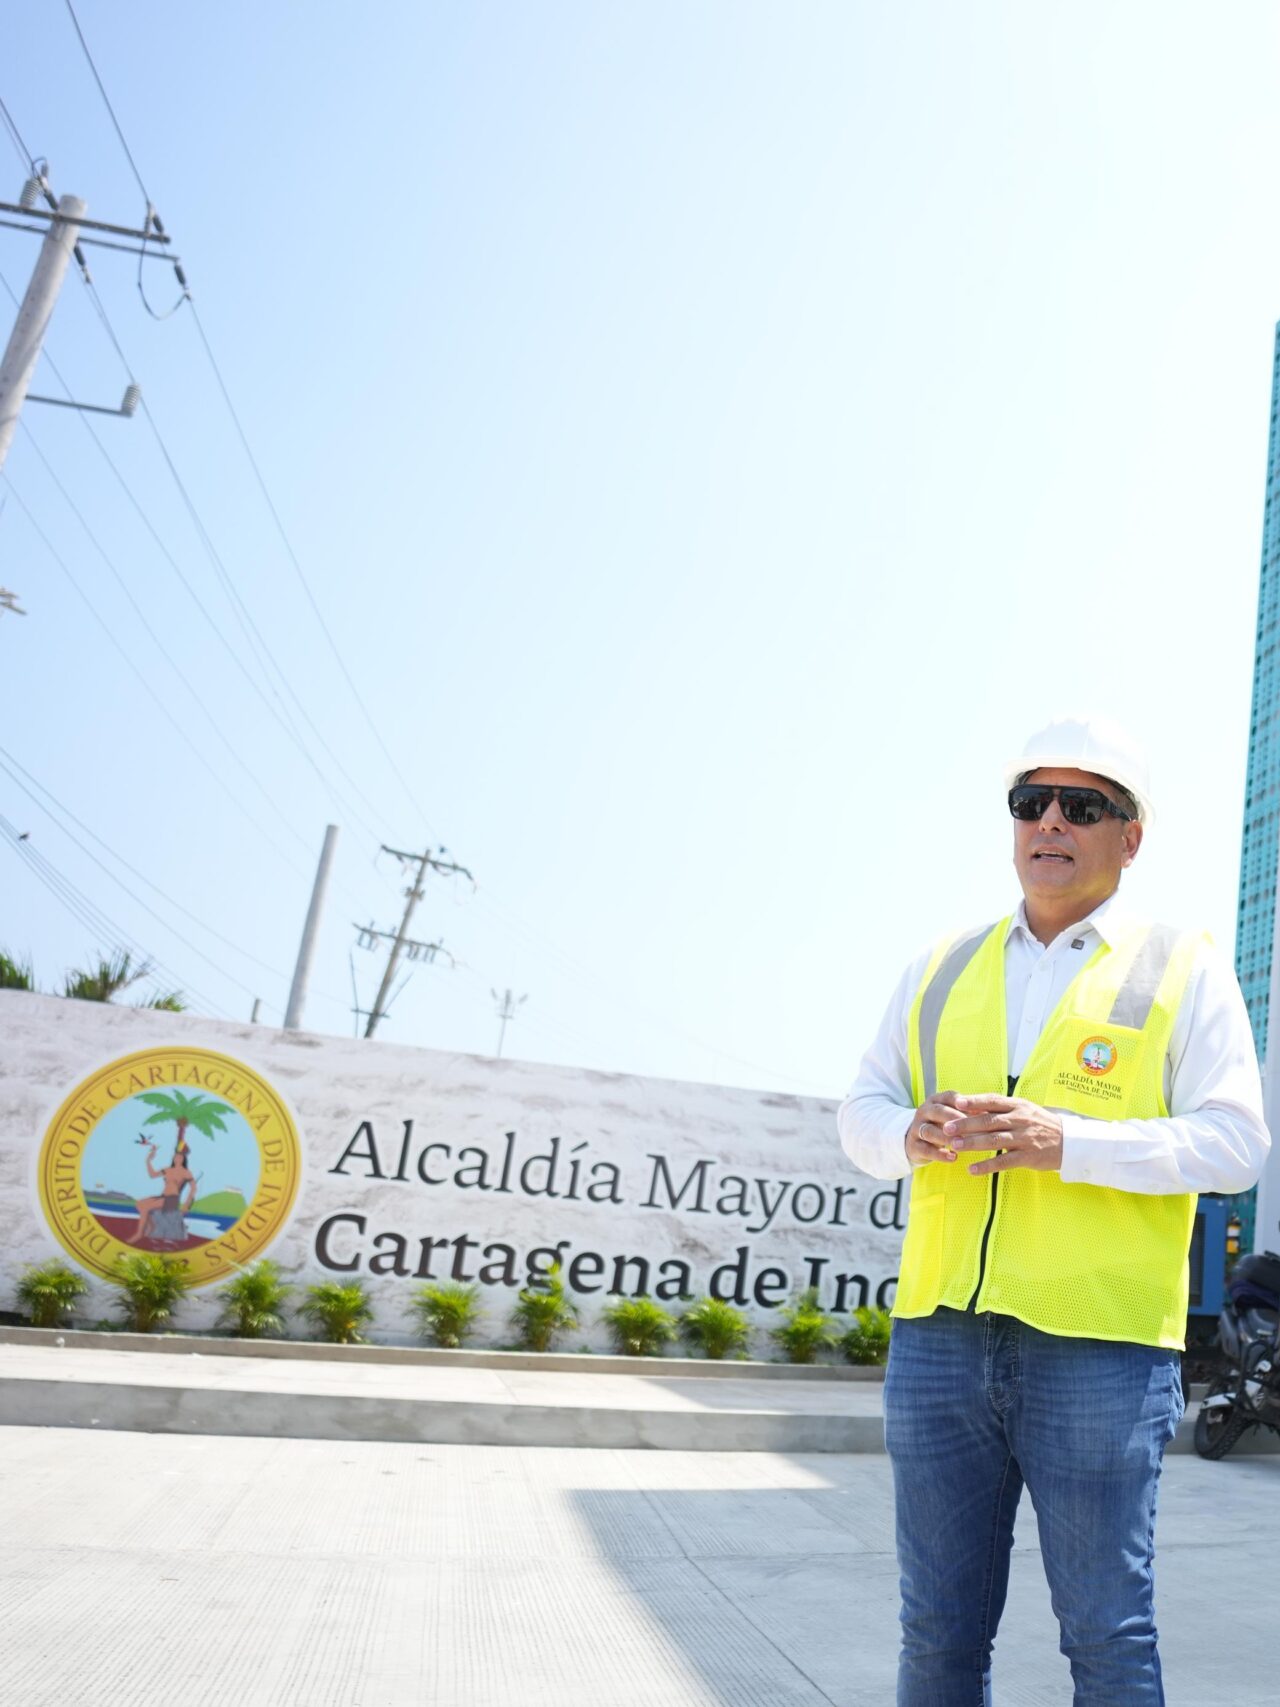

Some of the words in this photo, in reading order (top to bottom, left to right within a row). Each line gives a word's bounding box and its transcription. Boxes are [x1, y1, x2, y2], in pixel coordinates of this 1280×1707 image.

[68, 1100, 104, 1136] DE
[106, 1063, 272, 1131] CARTAGENA
[1096, 1080, 1122, 1093] MAYOR
[262, 1139, 285, 1174] DE
[328, 1119, 625, 1204] Alcaldía
[639, 1153, 857, 1233] Mayor
[869, 1179, 906, 1230] d
[55, 1139, 111, 1254] DISTRITO
[204, 1183, 282, 1267] INDIAS
[315, 1213, 695, 1300] Cartagena
[709, 1246, 788, 1308] de
